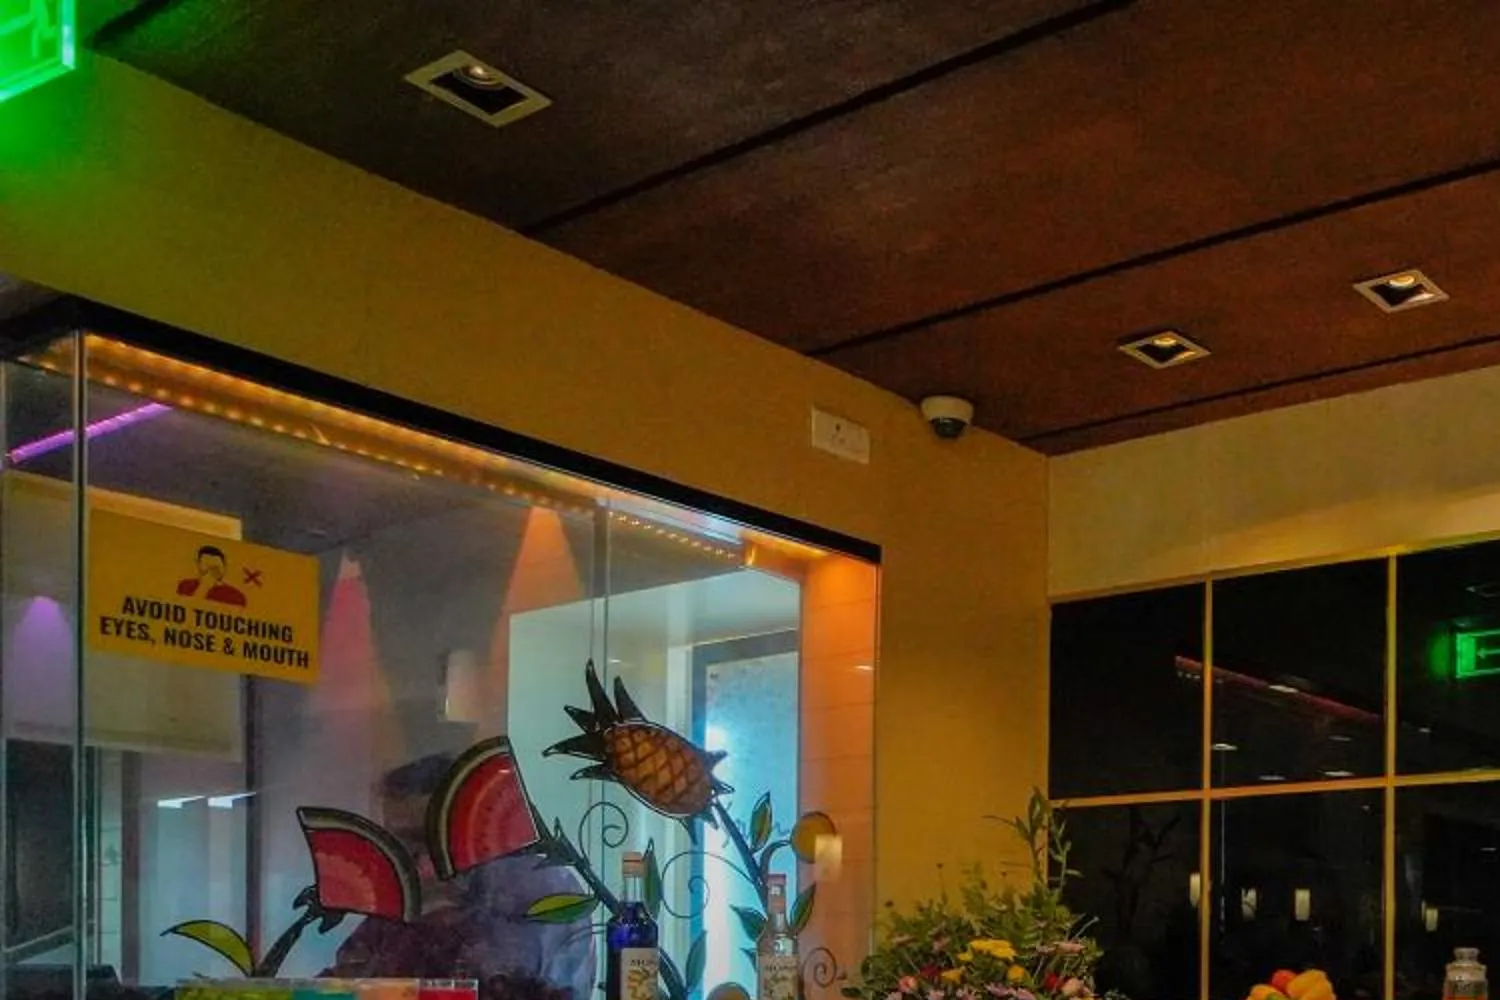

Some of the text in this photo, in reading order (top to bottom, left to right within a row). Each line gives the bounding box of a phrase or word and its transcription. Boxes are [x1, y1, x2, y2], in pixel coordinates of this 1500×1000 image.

[100, 615, 309, 668] EYES, NOSE & MOUTH
[122, 596, 293, 642] AVOID TOUCHING
